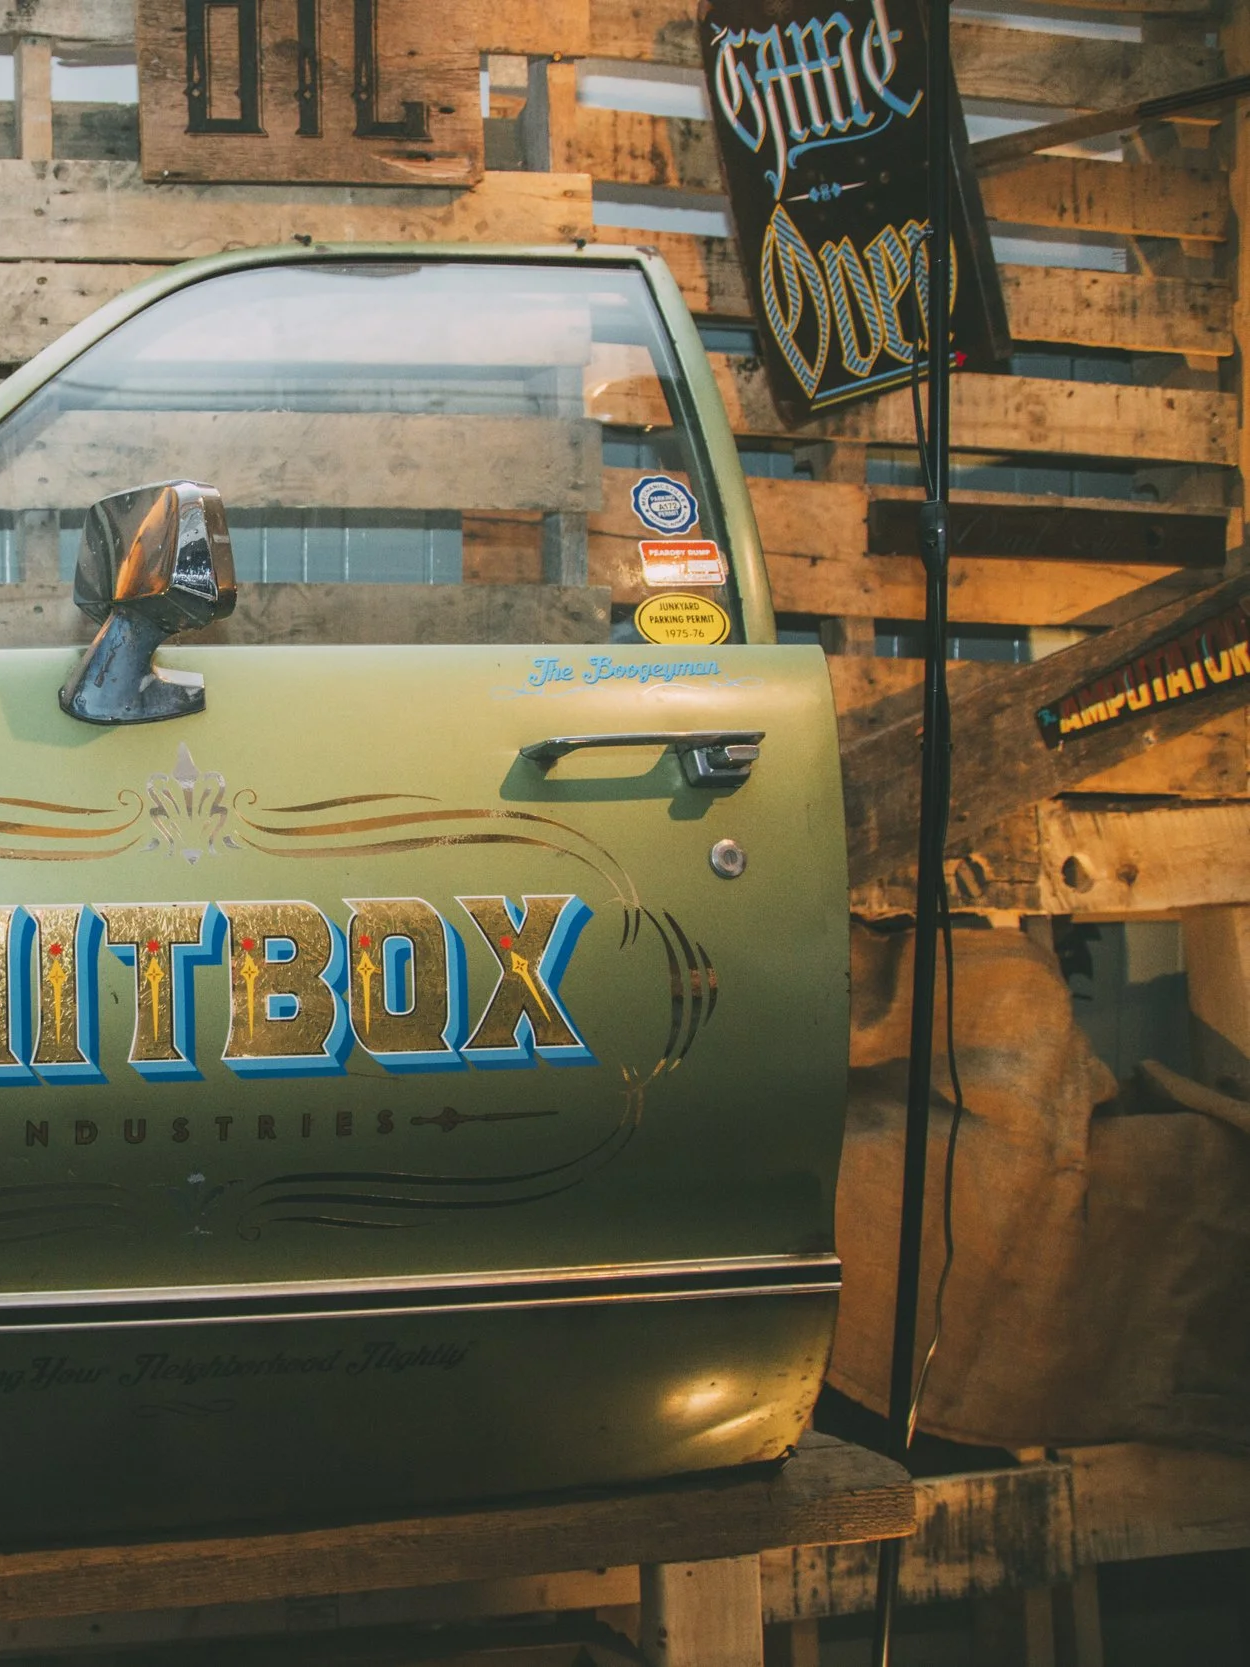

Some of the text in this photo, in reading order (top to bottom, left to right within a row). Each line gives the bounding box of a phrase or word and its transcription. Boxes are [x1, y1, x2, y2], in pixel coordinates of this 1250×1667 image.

[184, 0, 432, 141] OIL
[687, 549, 711, 557] DUMP
[659, 602, 700, 611] JUNKYARD
[649, 614, 715, 624] PARKING PERMIT
[664, 628, 705, 638] 1975-76
[528, 655, 722, 686] The Boogeyman
